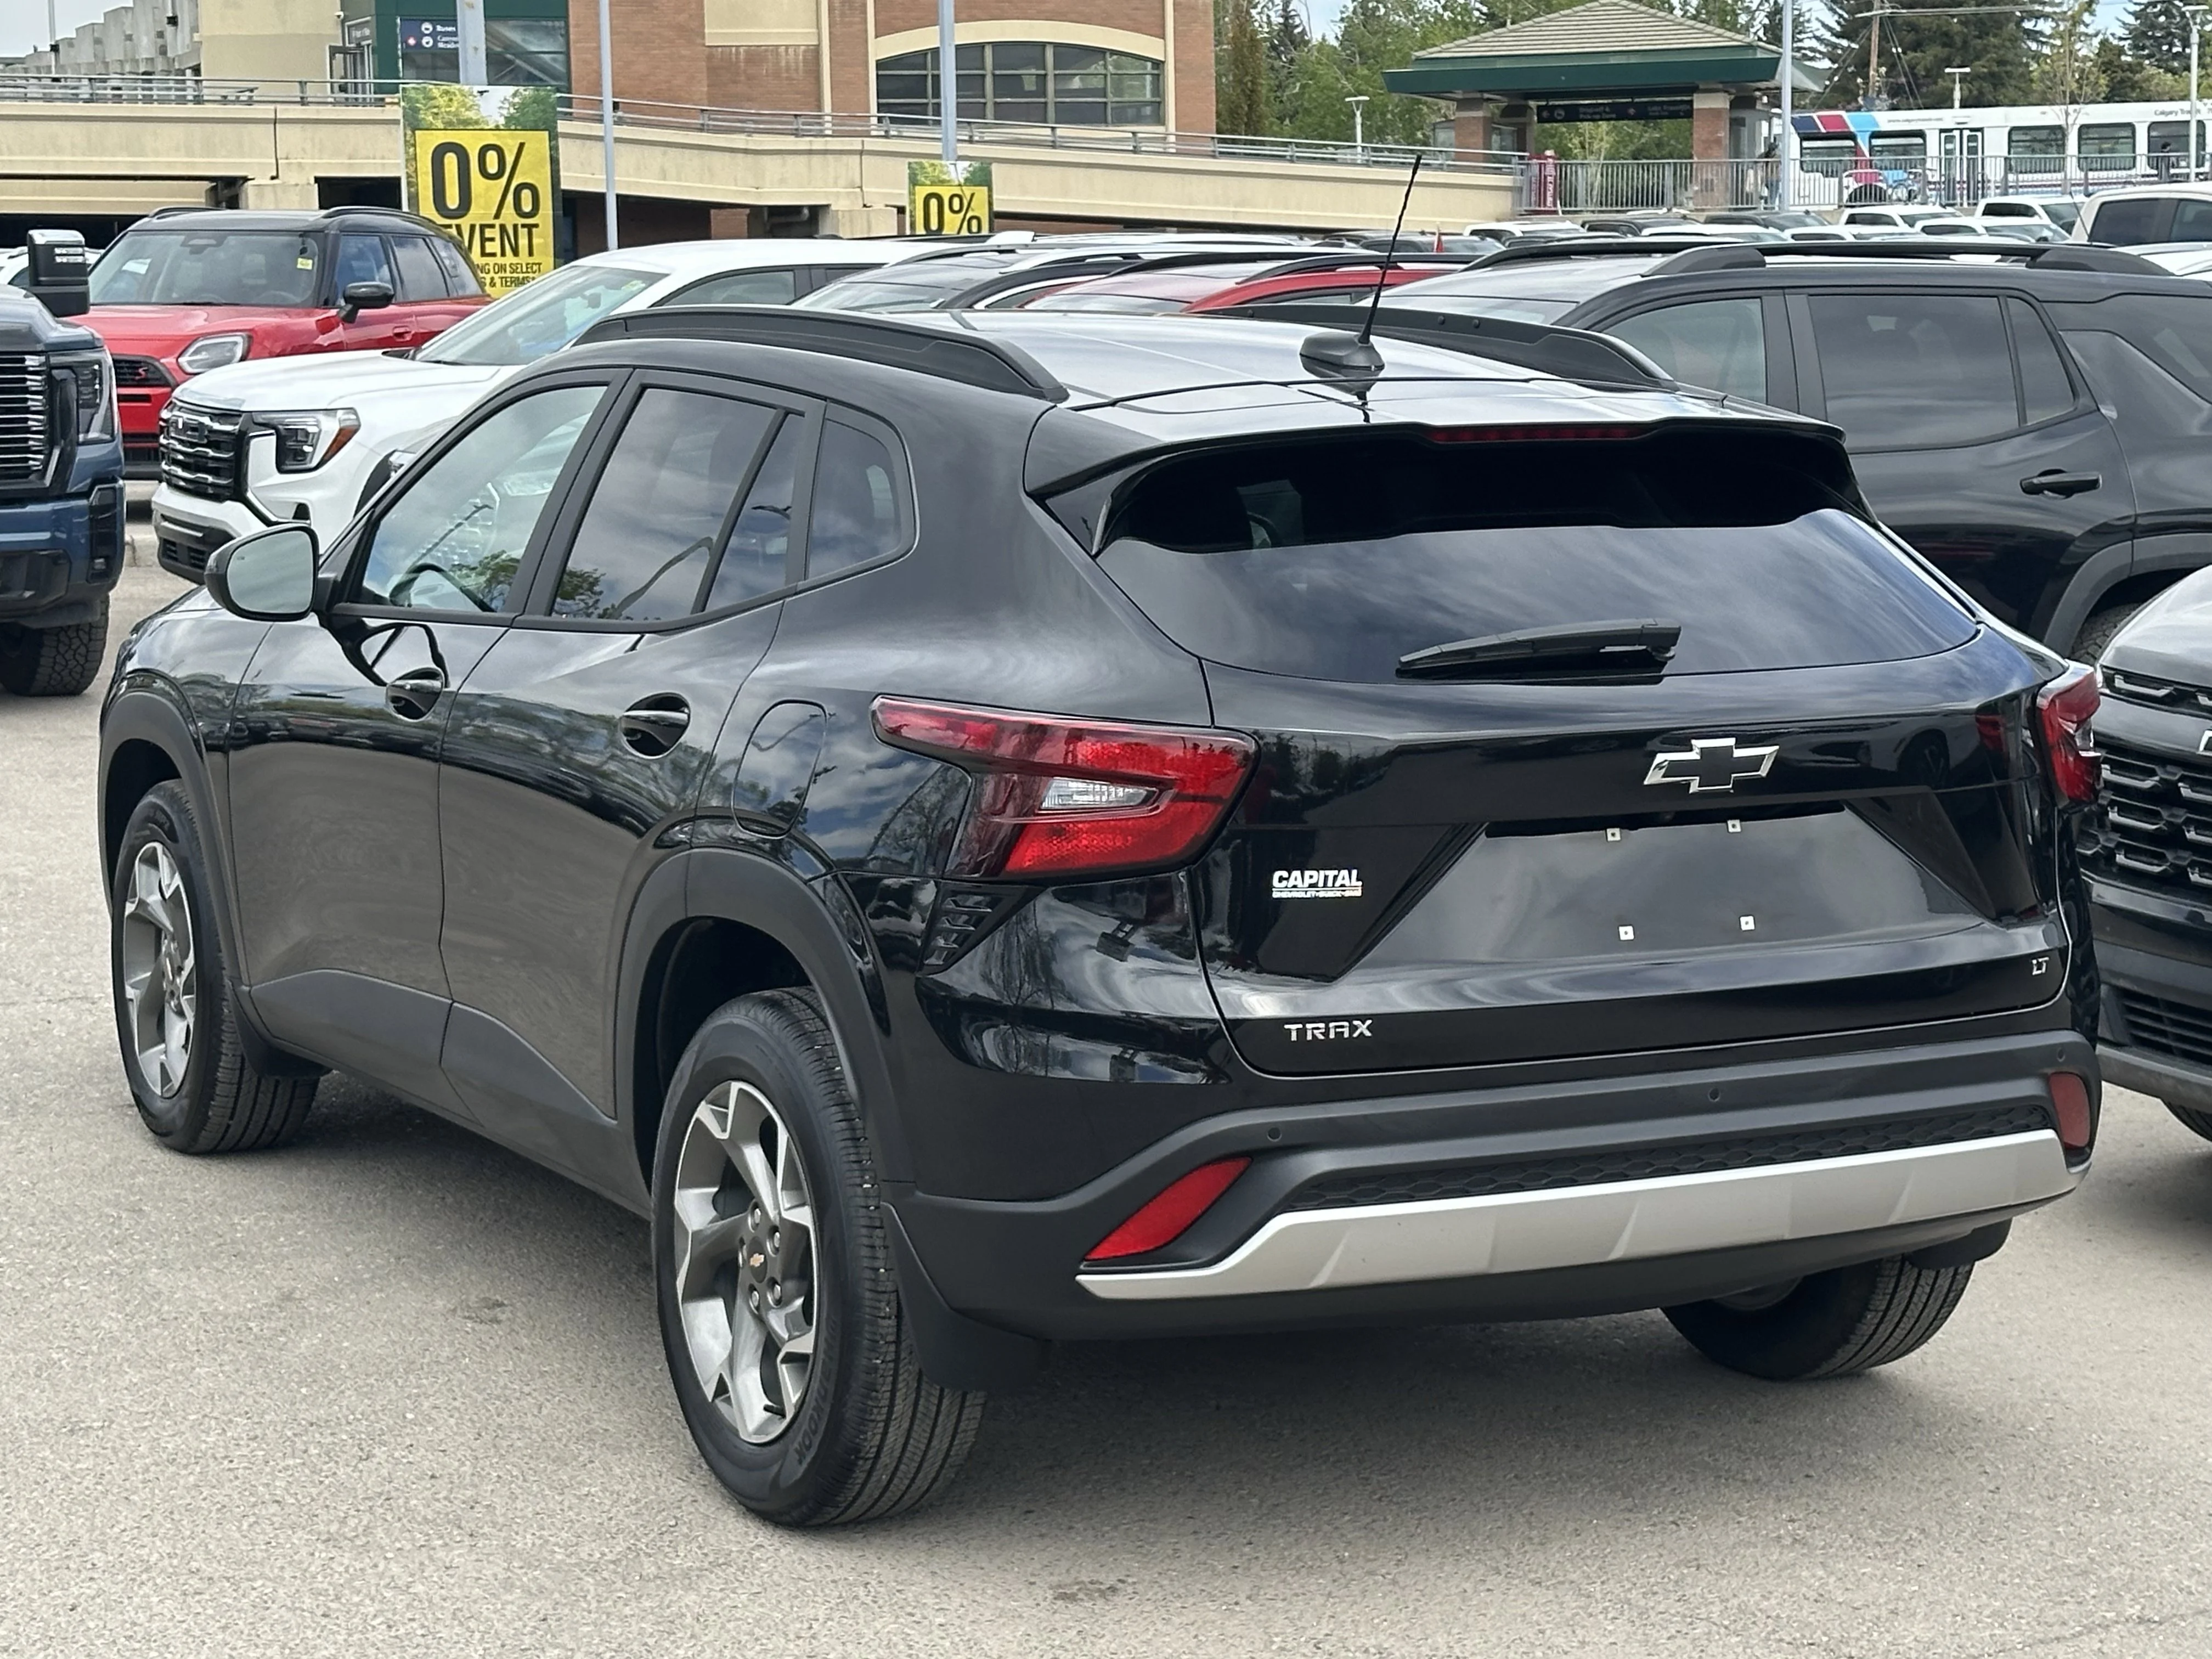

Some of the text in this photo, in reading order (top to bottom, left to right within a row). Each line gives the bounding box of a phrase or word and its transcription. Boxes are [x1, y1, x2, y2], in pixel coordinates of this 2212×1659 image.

[431, 142, 541, 219] 0%
[923, 192, 983, 235] 0%
[438, 223, 540, 257] VENT
[493, 263, 507, 274] ON
[509, 262, 543, 274] SELECT
[134, 366, 149, 380] S
[1272, 869, 1363, 888] CAPITAL
[2032, 957, 2050, 975] LT
[1283, 1019, 1373, 1041] TRAX
